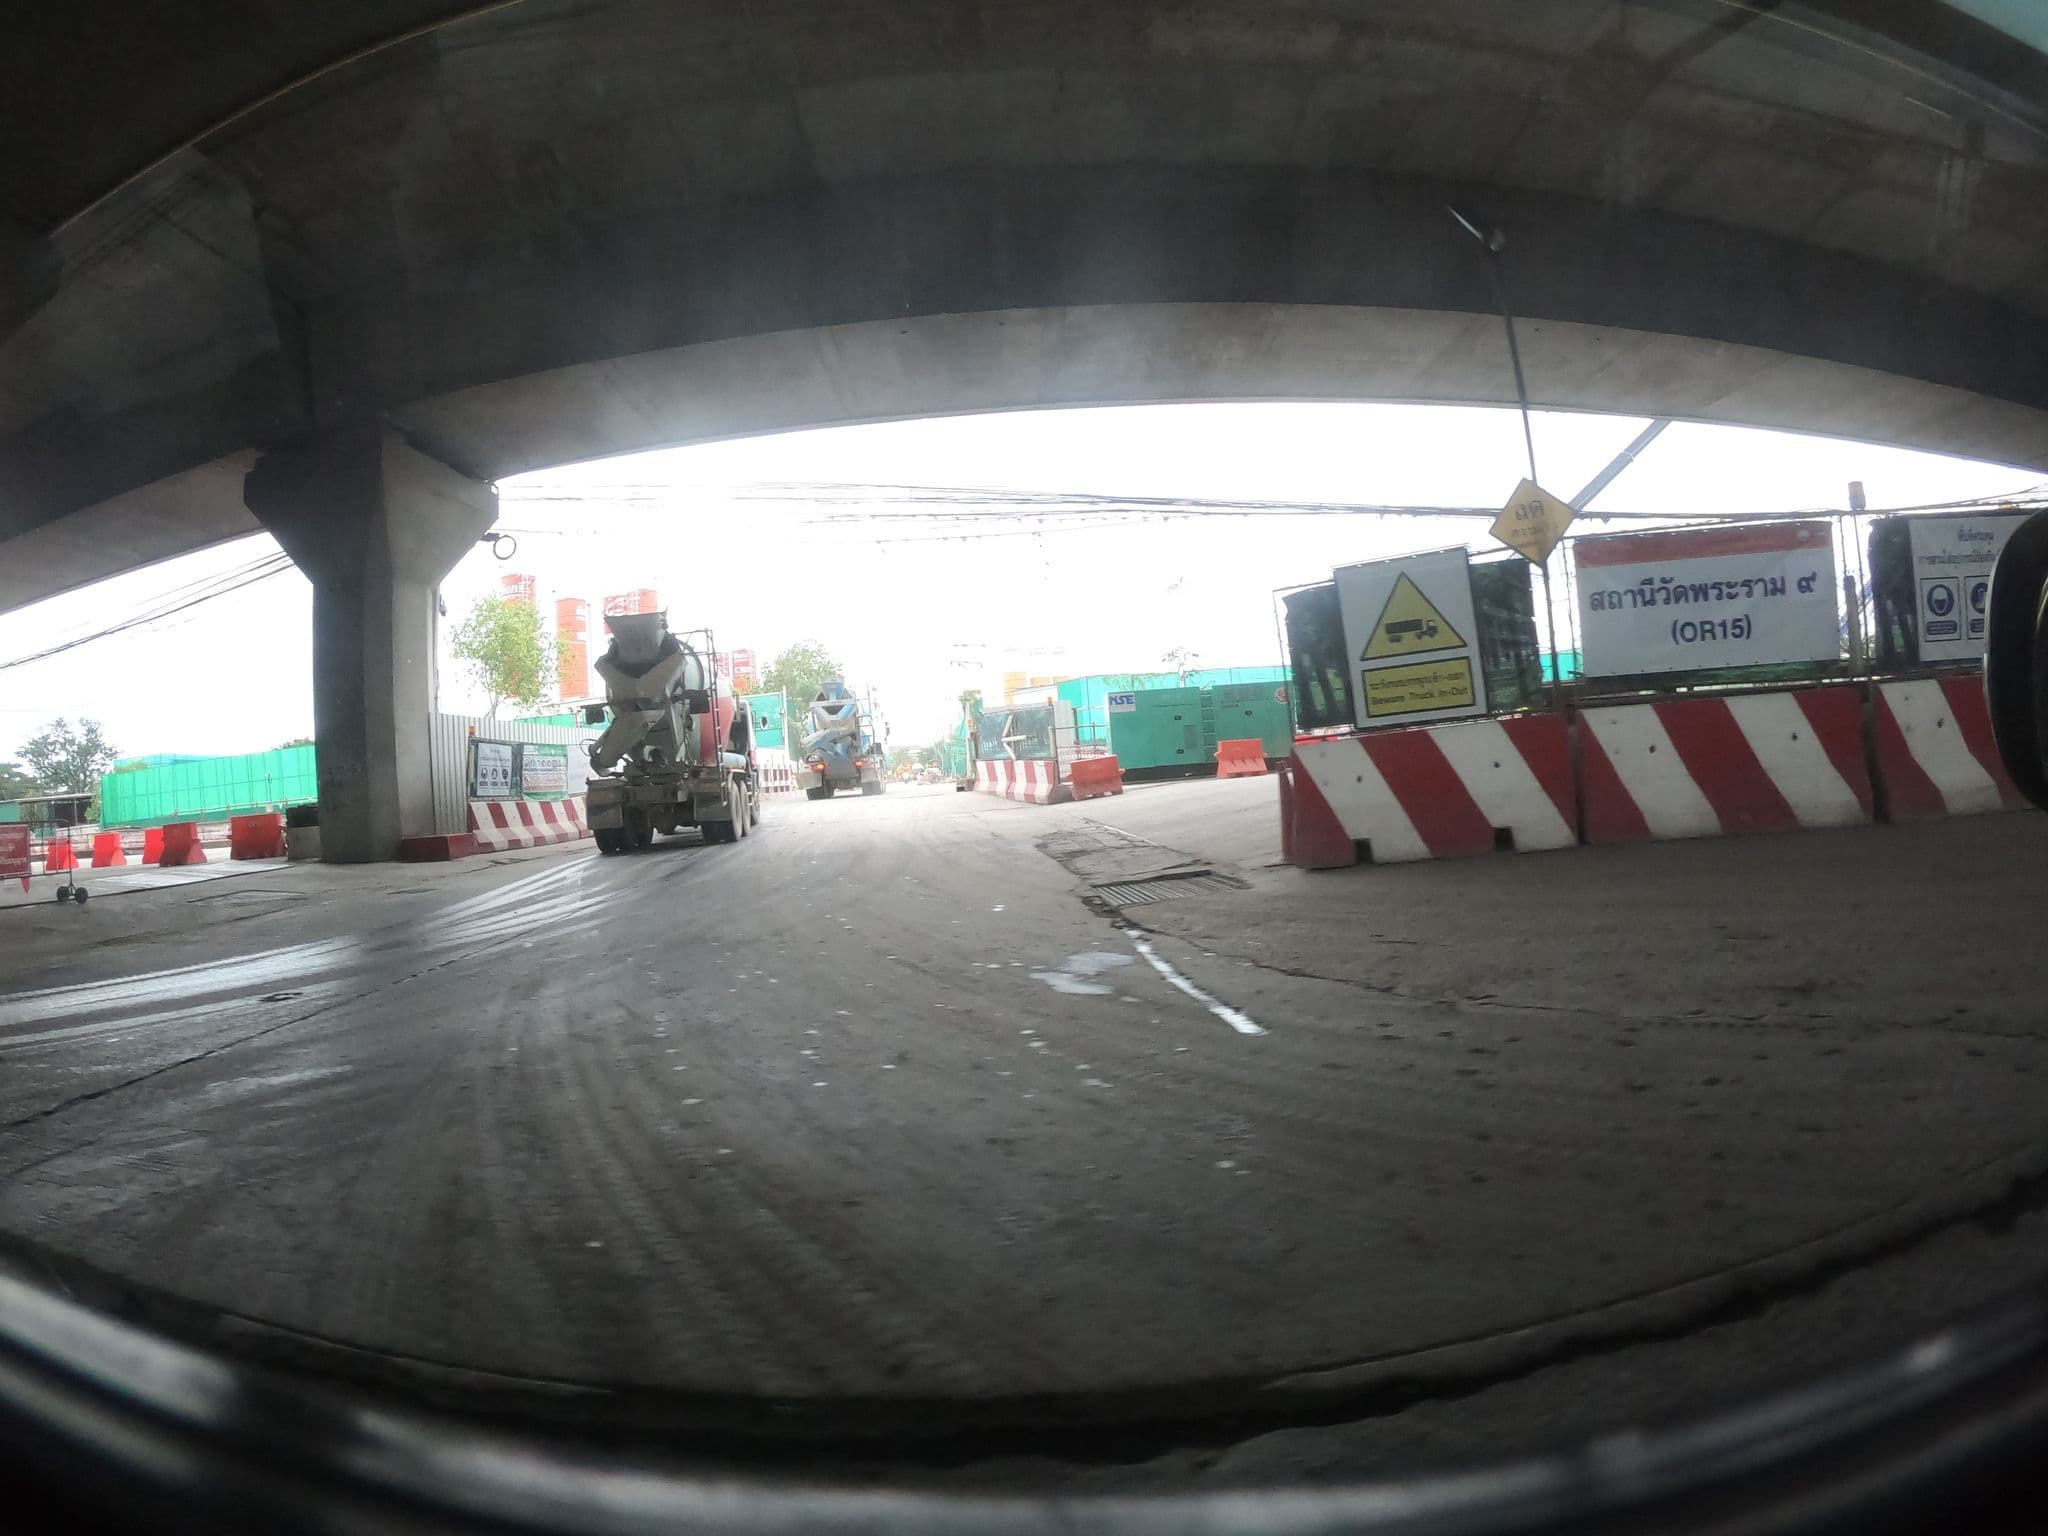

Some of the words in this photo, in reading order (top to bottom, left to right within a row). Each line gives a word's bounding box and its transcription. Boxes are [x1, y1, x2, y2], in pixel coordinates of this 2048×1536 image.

[1589, 576, 1785, 611] สถานีวัดพระราม
[1796, 570, 1818, 595] ๙
[1671, 614, 1752, 645] (OR15)
